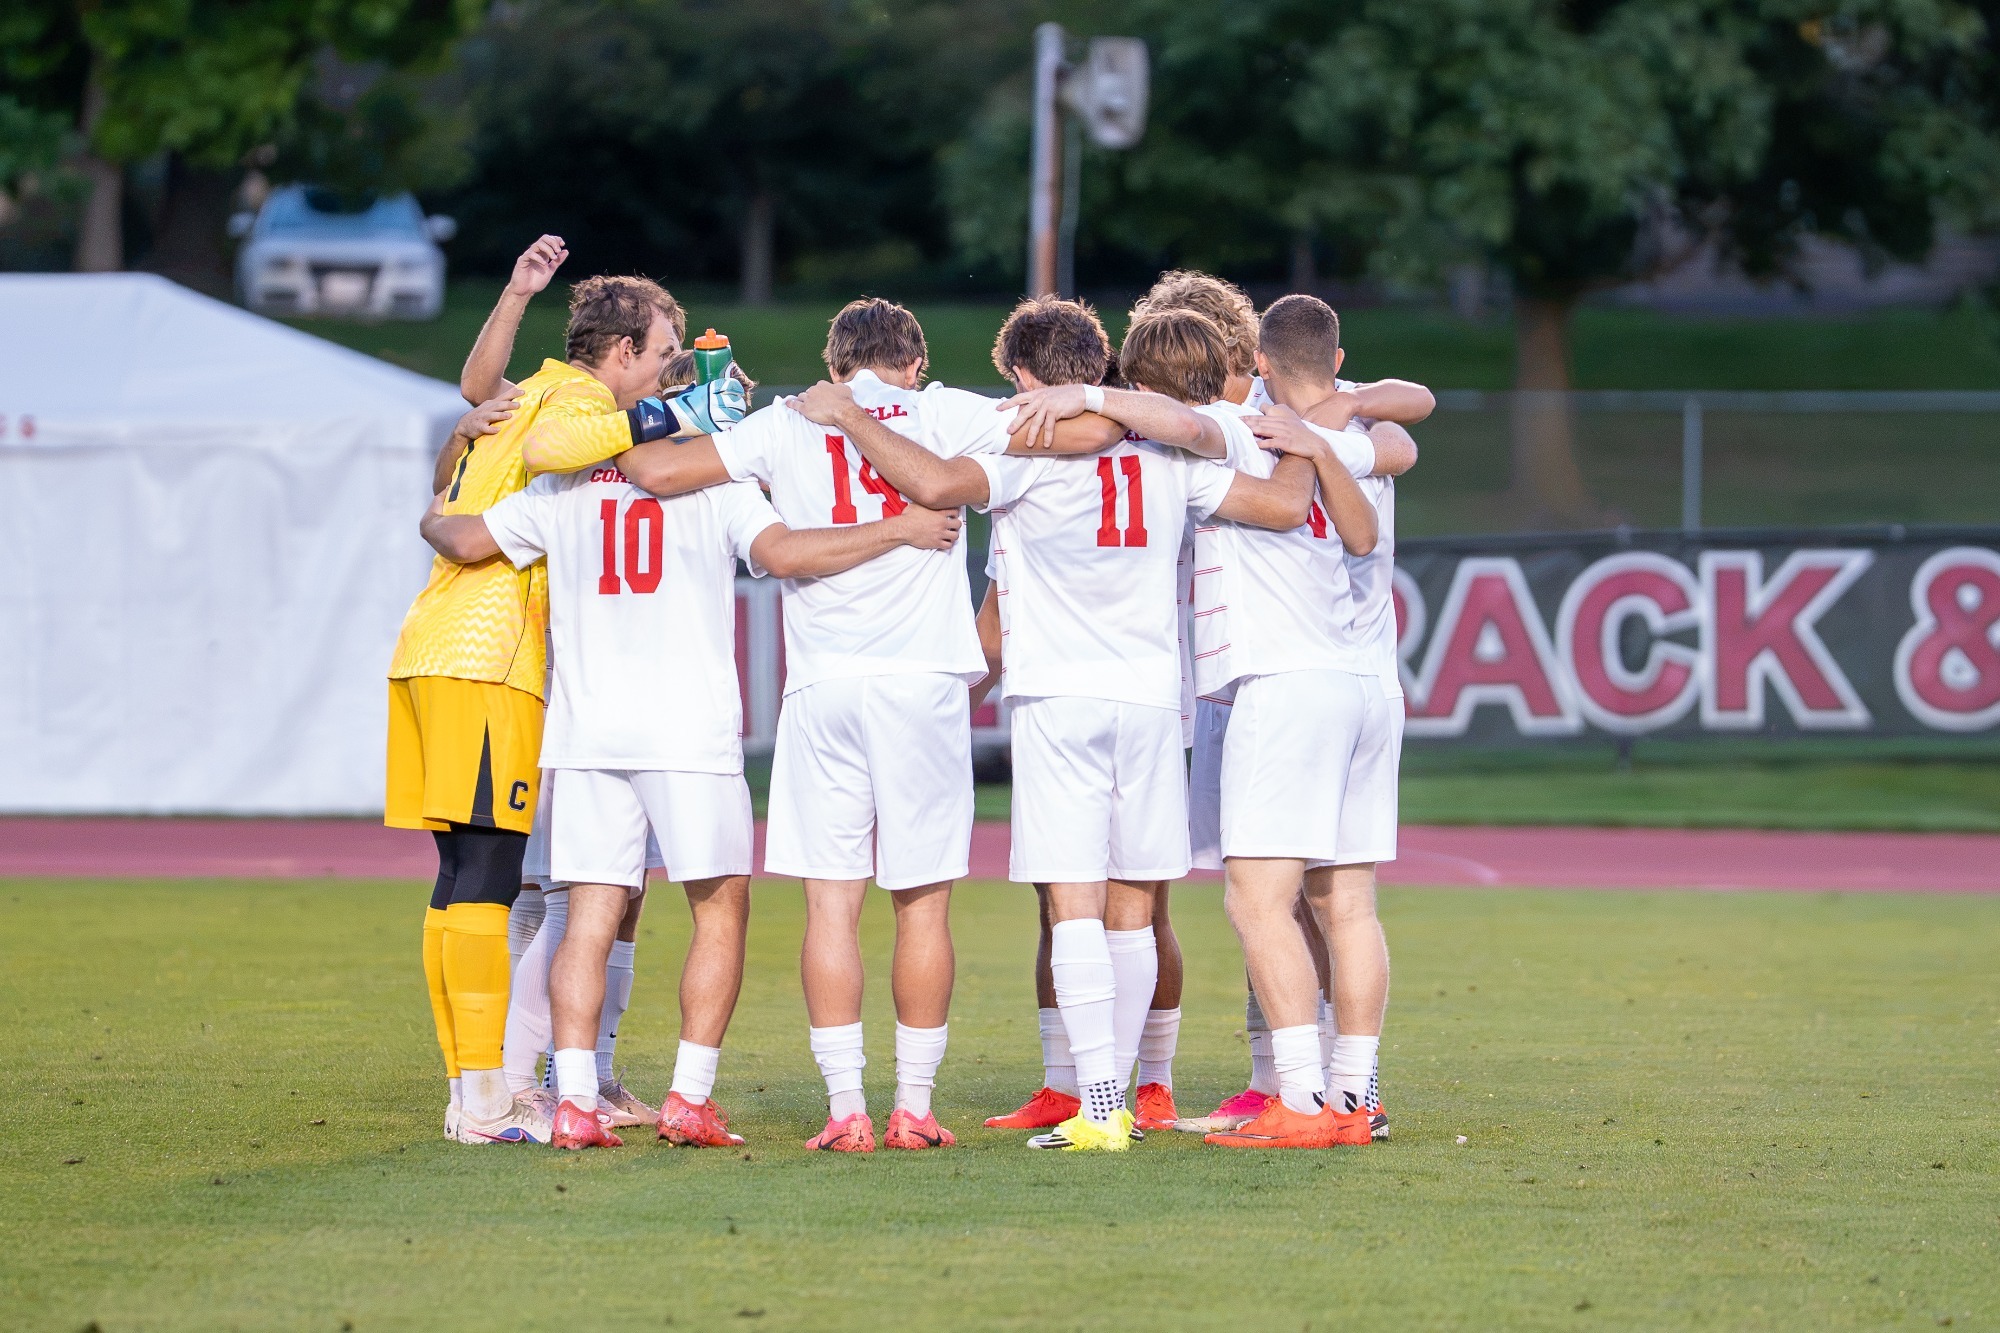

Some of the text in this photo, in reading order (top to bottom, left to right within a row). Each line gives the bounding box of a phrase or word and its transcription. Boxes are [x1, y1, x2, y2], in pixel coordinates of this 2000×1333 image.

[599, 498, 663, 594] 10
[1096, 454, 1147, 547] 11
[1894, 546, 2000, 731] &
[509, 780, 528, 812] C
